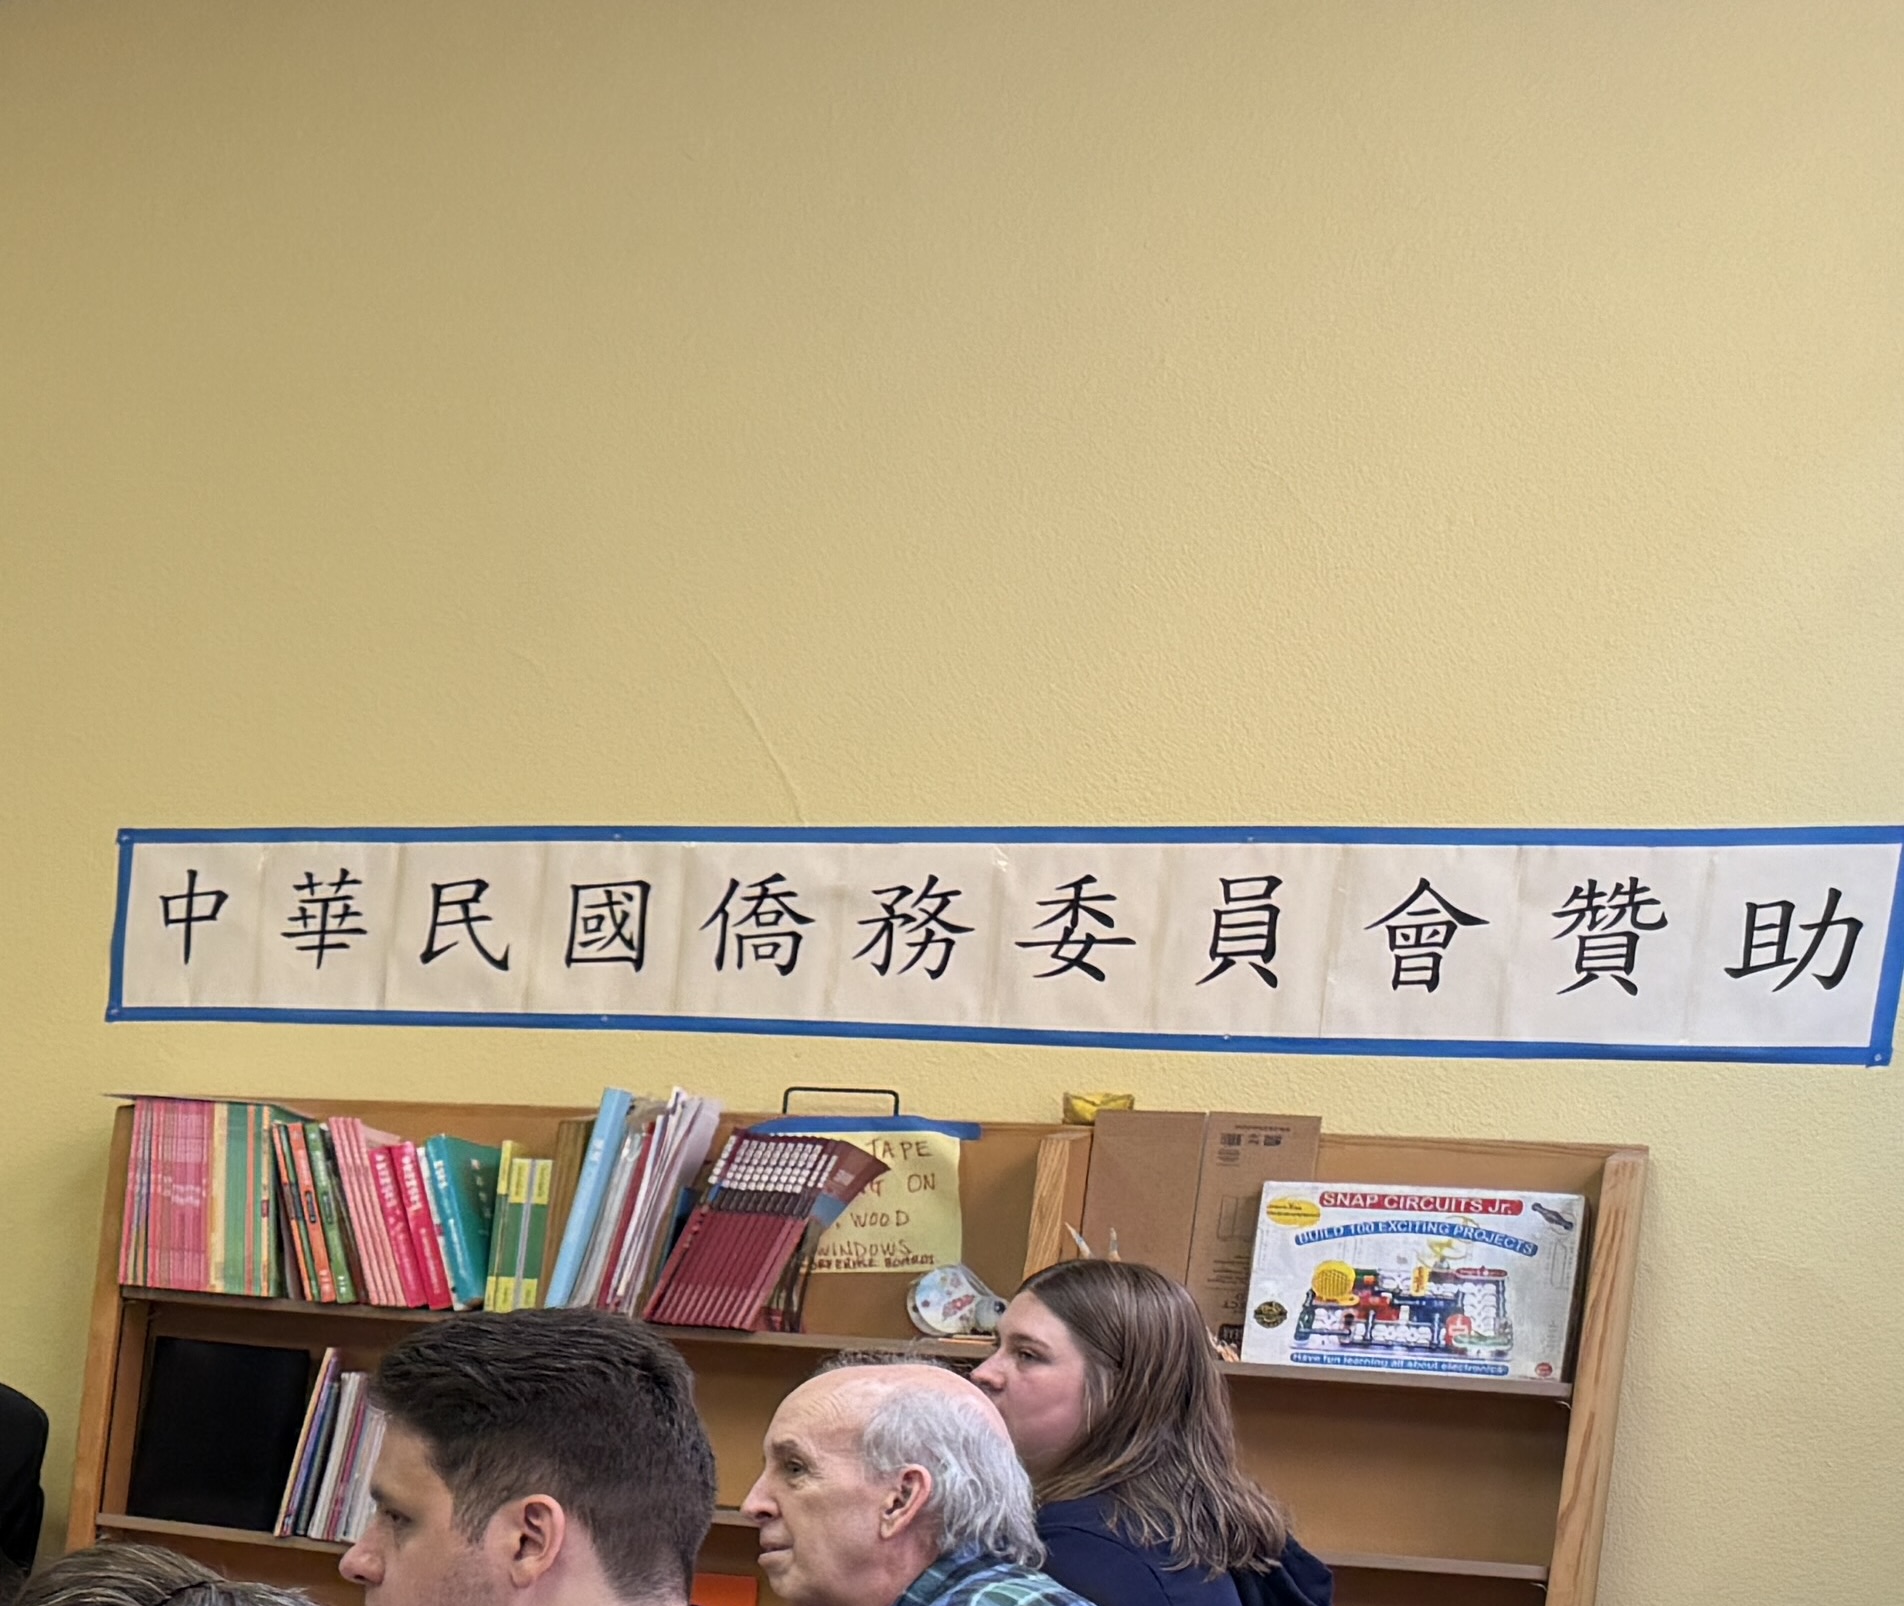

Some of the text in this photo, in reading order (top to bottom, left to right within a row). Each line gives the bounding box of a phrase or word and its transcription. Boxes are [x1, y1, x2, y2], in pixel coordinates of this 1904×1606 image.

[157, 868, 1864, 998] 中華民國僑務委員會贊助
[866, 1138, 934, 1162] TAPE
[907, 1172, 936, 1193] ON
[1321, 1192, 1378, 1209] SNAP
[1383, 1195, 1483, 1213] CIRCUITS
[1486, 1199, 1514, 1215] Jr.
[849, 1209, 910, 1228] WOOD
[1297, 1219, 1536, 1257] BUILD 100 EXCITING PROJECTS
